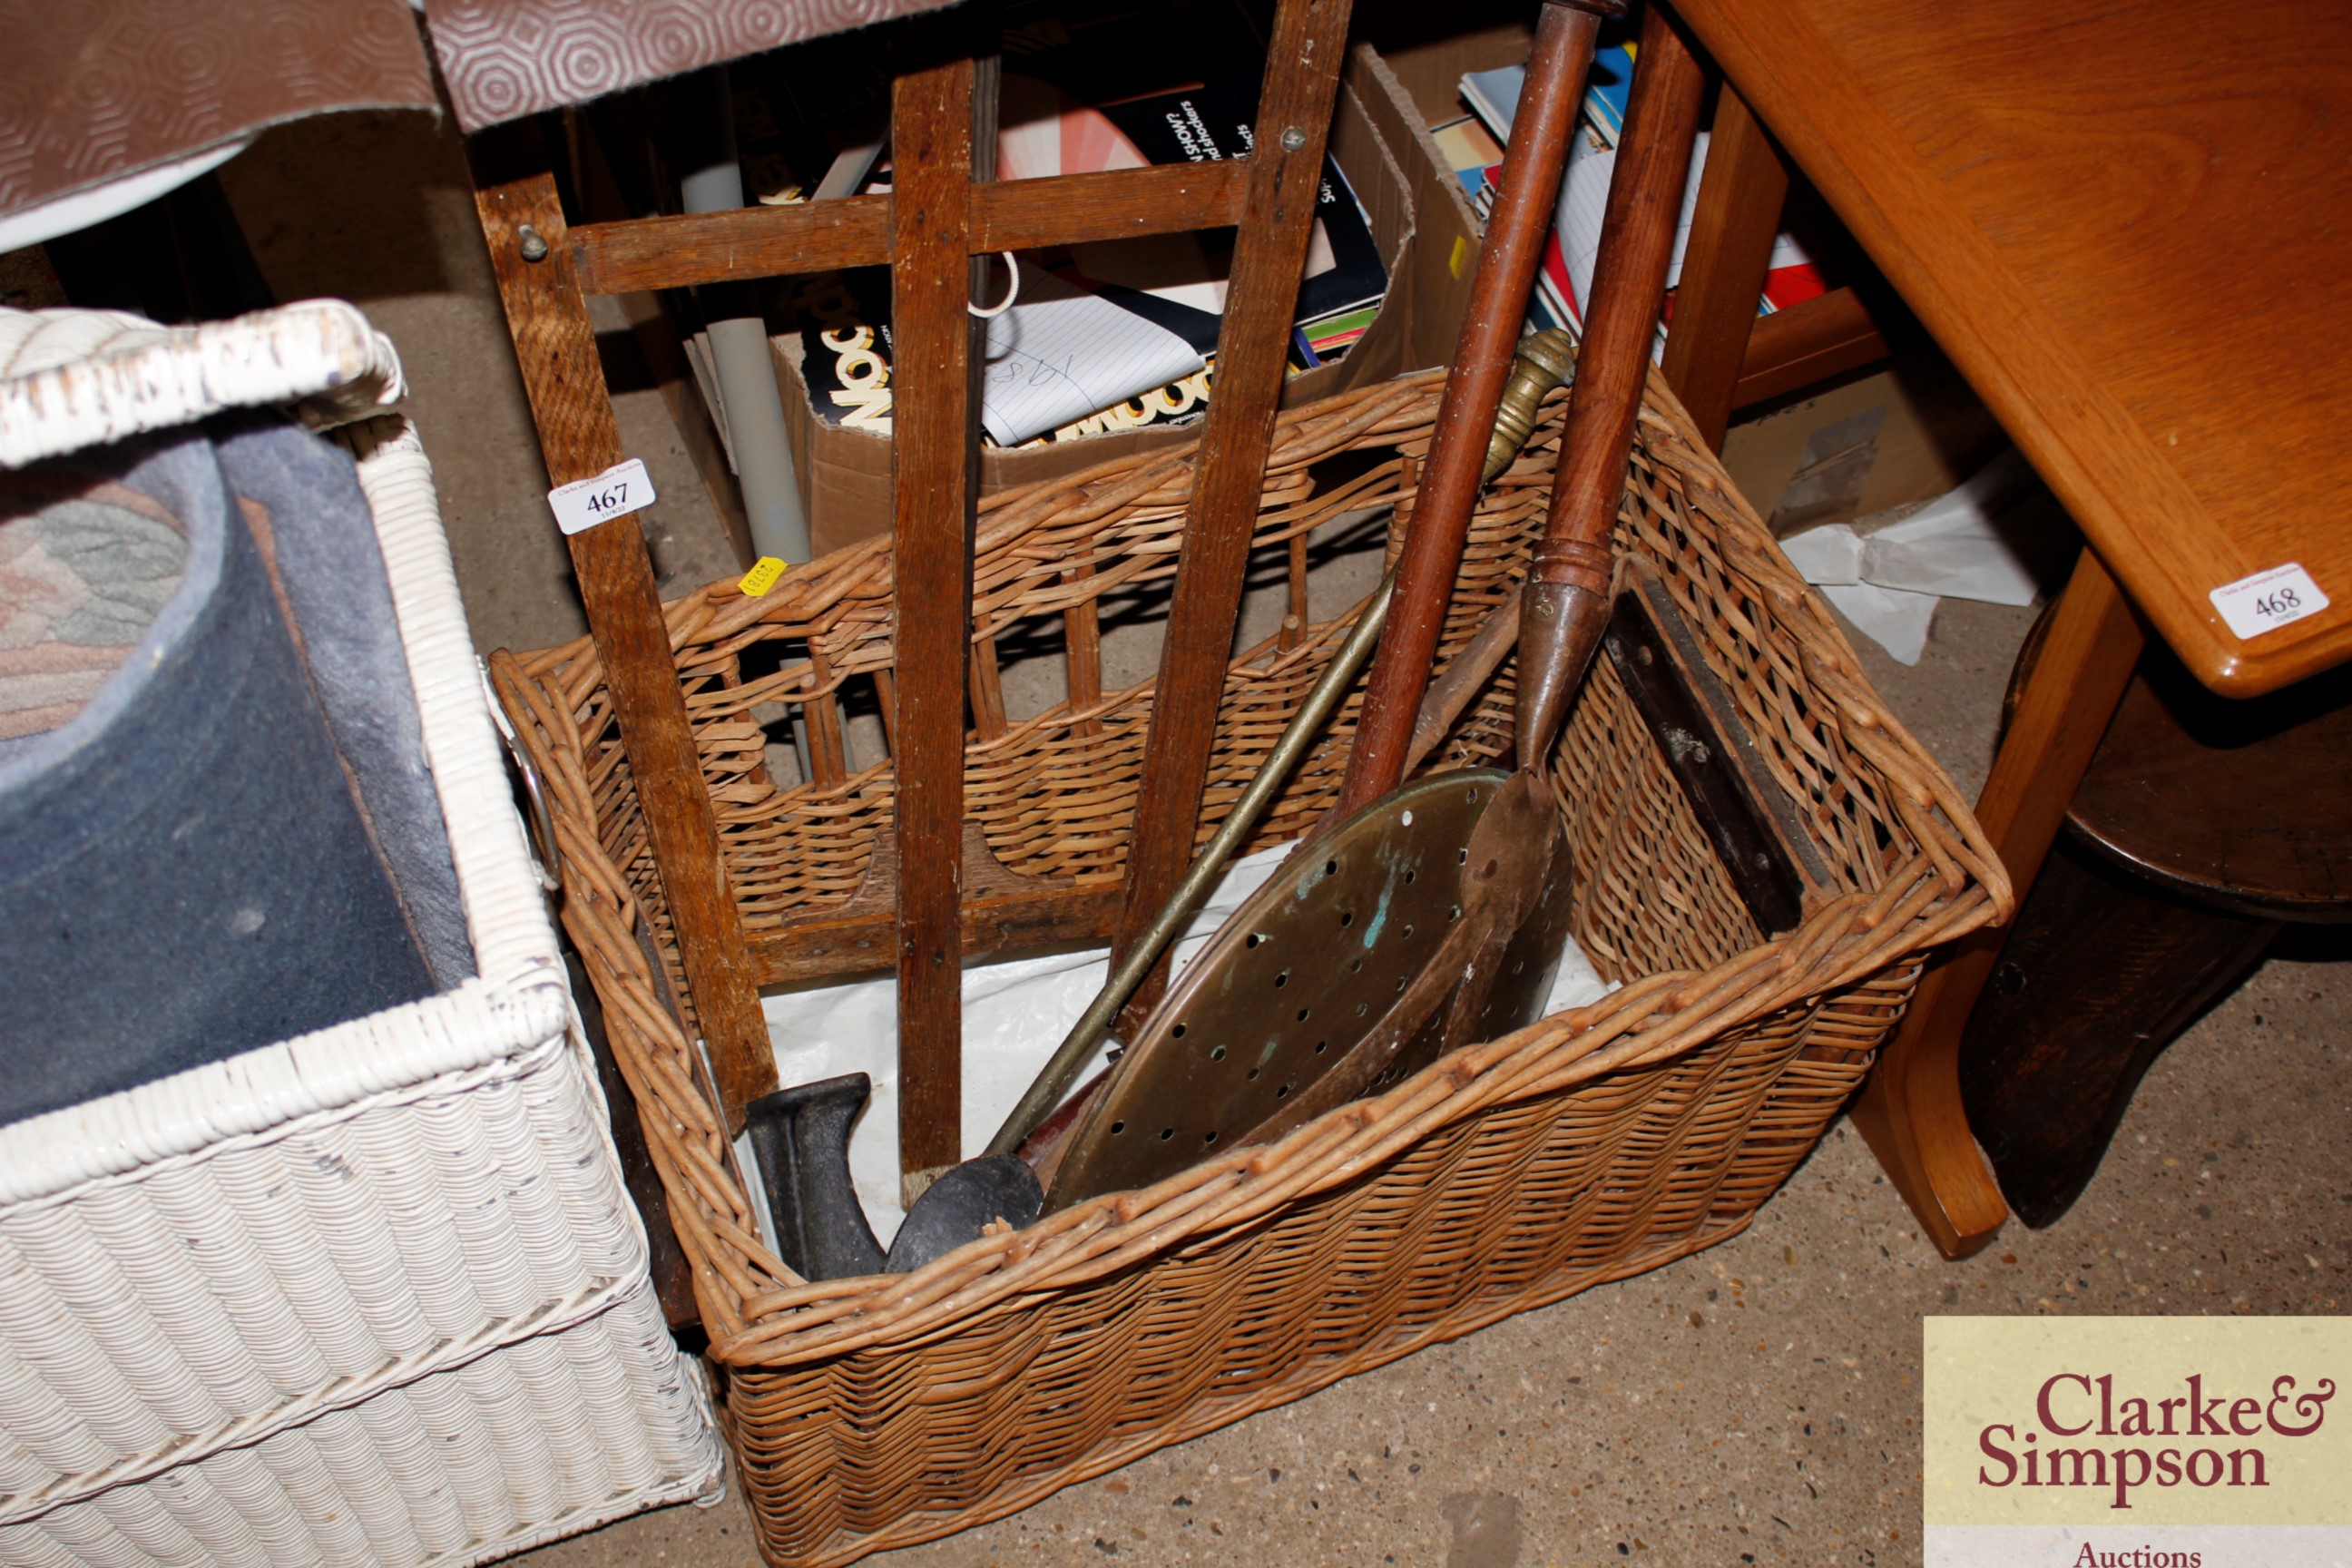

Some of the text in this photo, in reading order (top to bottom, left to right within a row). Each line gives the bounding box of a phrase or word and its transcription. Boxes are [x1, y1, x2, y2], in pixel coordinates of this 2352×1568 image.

[1166, 113, 1200, 155] SHOW?
[1181, 101, 1215, 147] shockers
[587, 483, 628, 513] 467
[742, 564, 773, 592] 23781
[2256, 588, 2301, 616] 468
